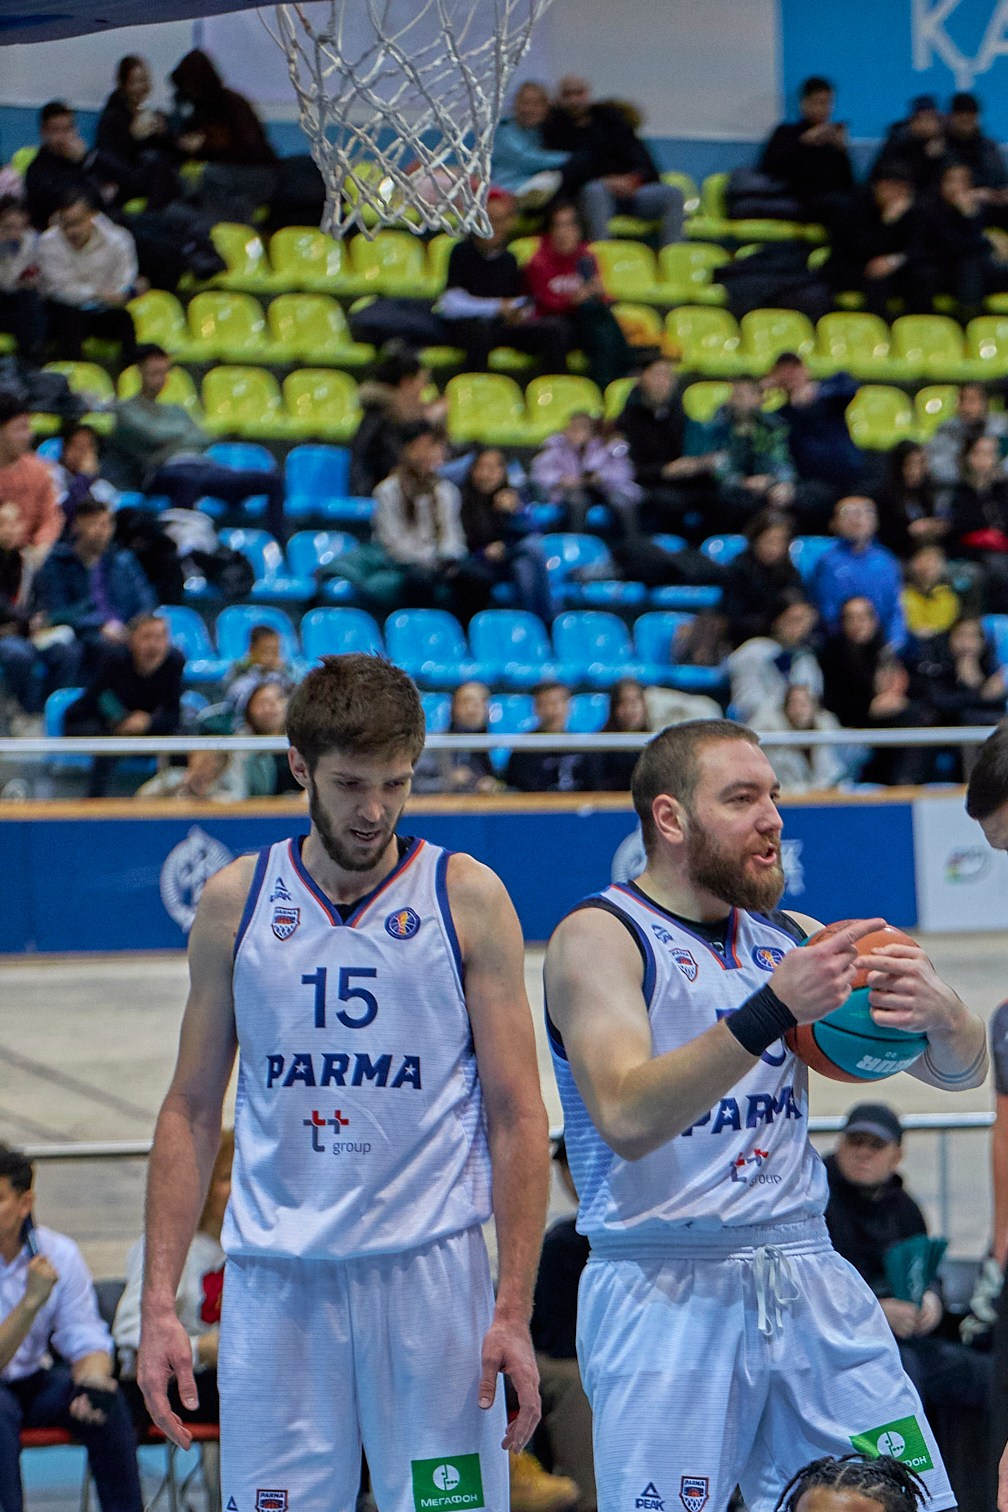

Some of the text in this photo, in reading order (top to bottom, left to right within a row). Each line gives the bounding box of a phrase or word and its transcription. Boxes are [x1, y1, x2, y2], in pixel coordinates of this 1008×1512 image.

[301, 967, 378, 1029] 15
[266, 1053, 422, 1089] PARMA
[332, 1139, 371, 1154] group
[635, 1498, 666, 1511] PEAK
